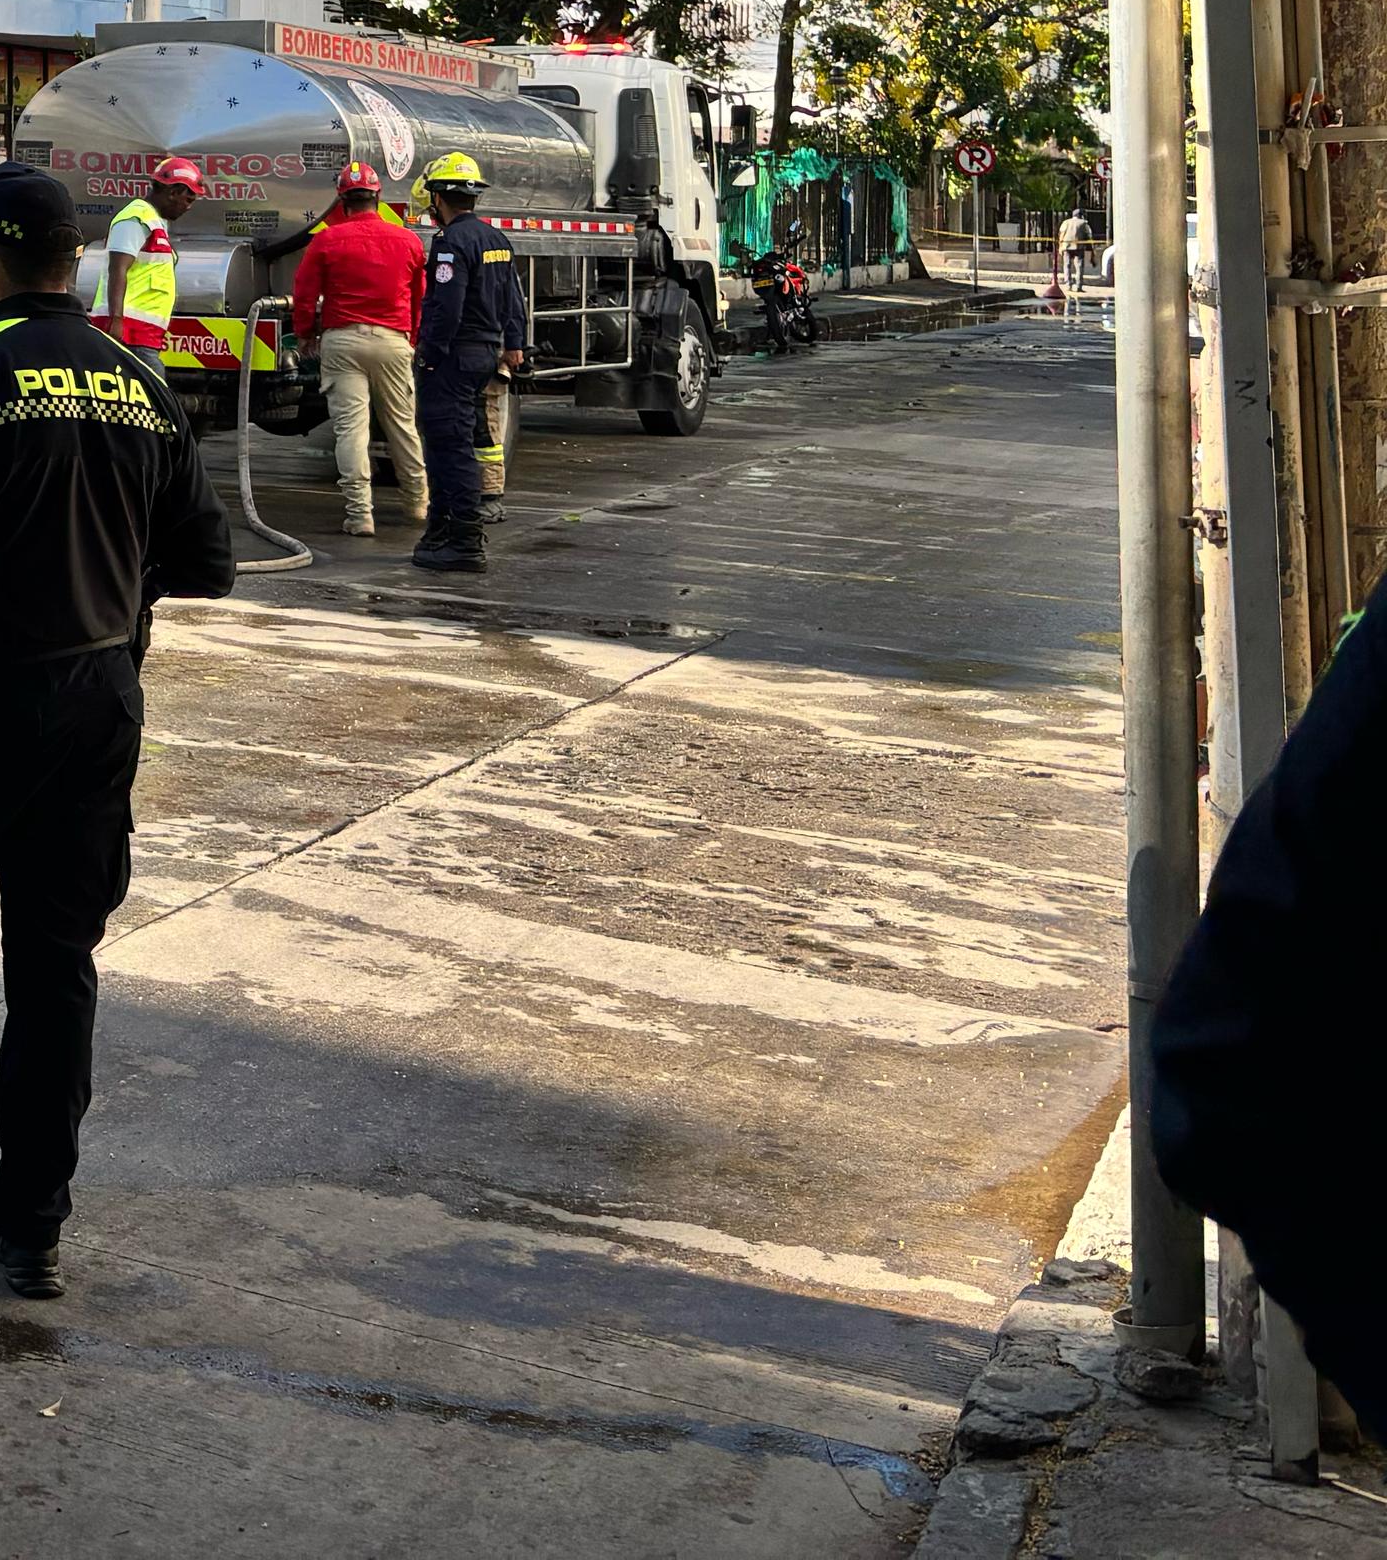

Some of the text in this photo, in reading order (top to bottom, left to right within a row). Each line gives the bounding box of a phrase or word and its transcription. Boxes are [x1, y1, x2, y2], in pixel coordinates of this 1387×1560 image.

[282, 27, 475, 84] BOMBEROS SANTA MARTA
[87, 177, 267, 201] SANT ARTA
[162, 332, 232, 356] STANCIA
[14, 365, 152, 409] POLICÍA
